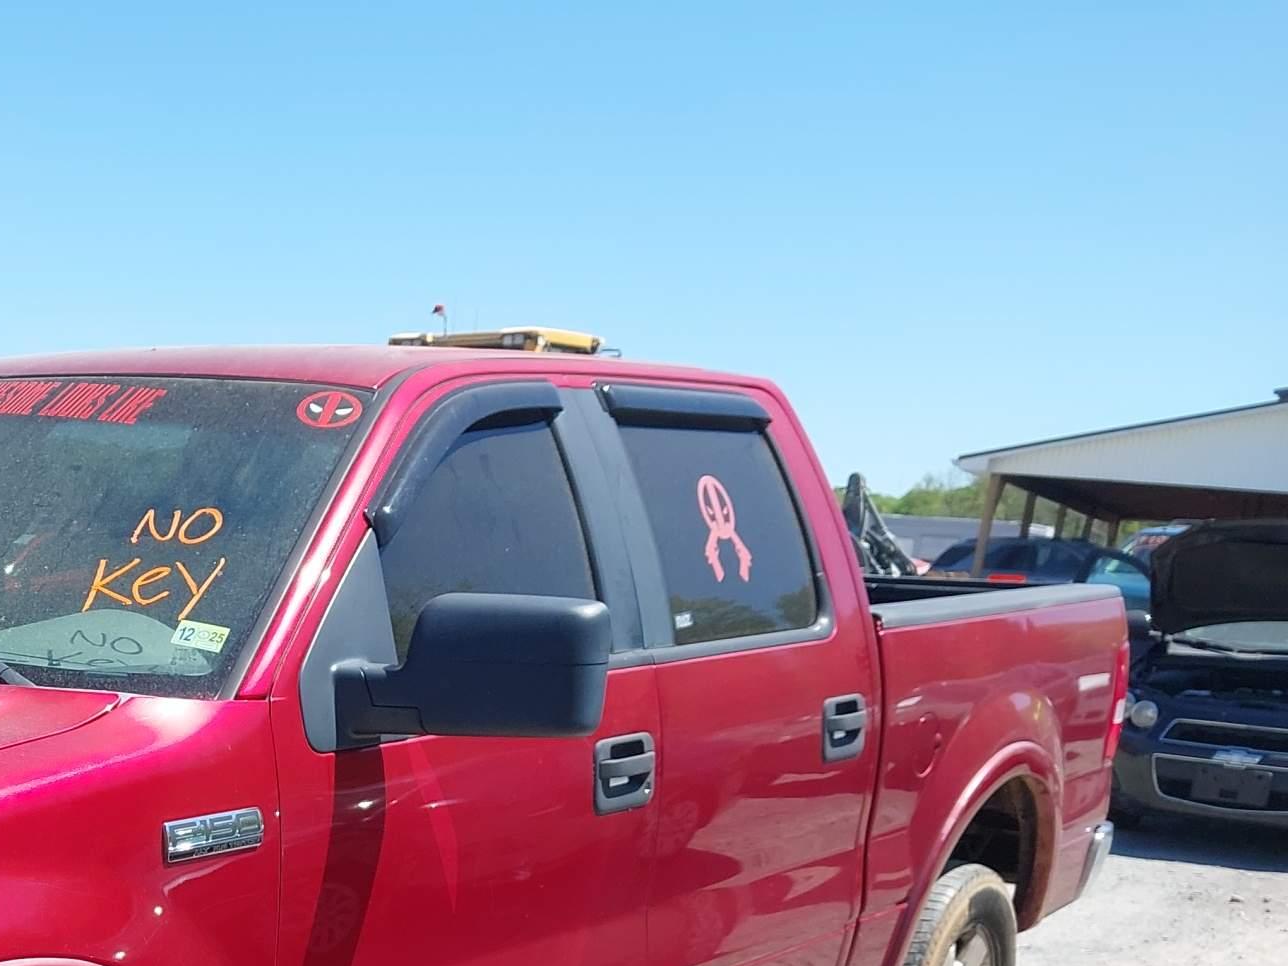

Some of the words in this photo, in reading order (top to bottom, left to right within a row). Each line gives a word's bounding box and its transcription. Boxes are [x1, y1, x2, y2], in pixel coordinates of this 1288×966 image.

[38, 382, 121, 420] LOOKS
[98, 386, 168, 425] LIKE
[130, 507, 224, 544] NO
[178, 626, 196, 642] 12
[208, 631, 225, 644] 25
